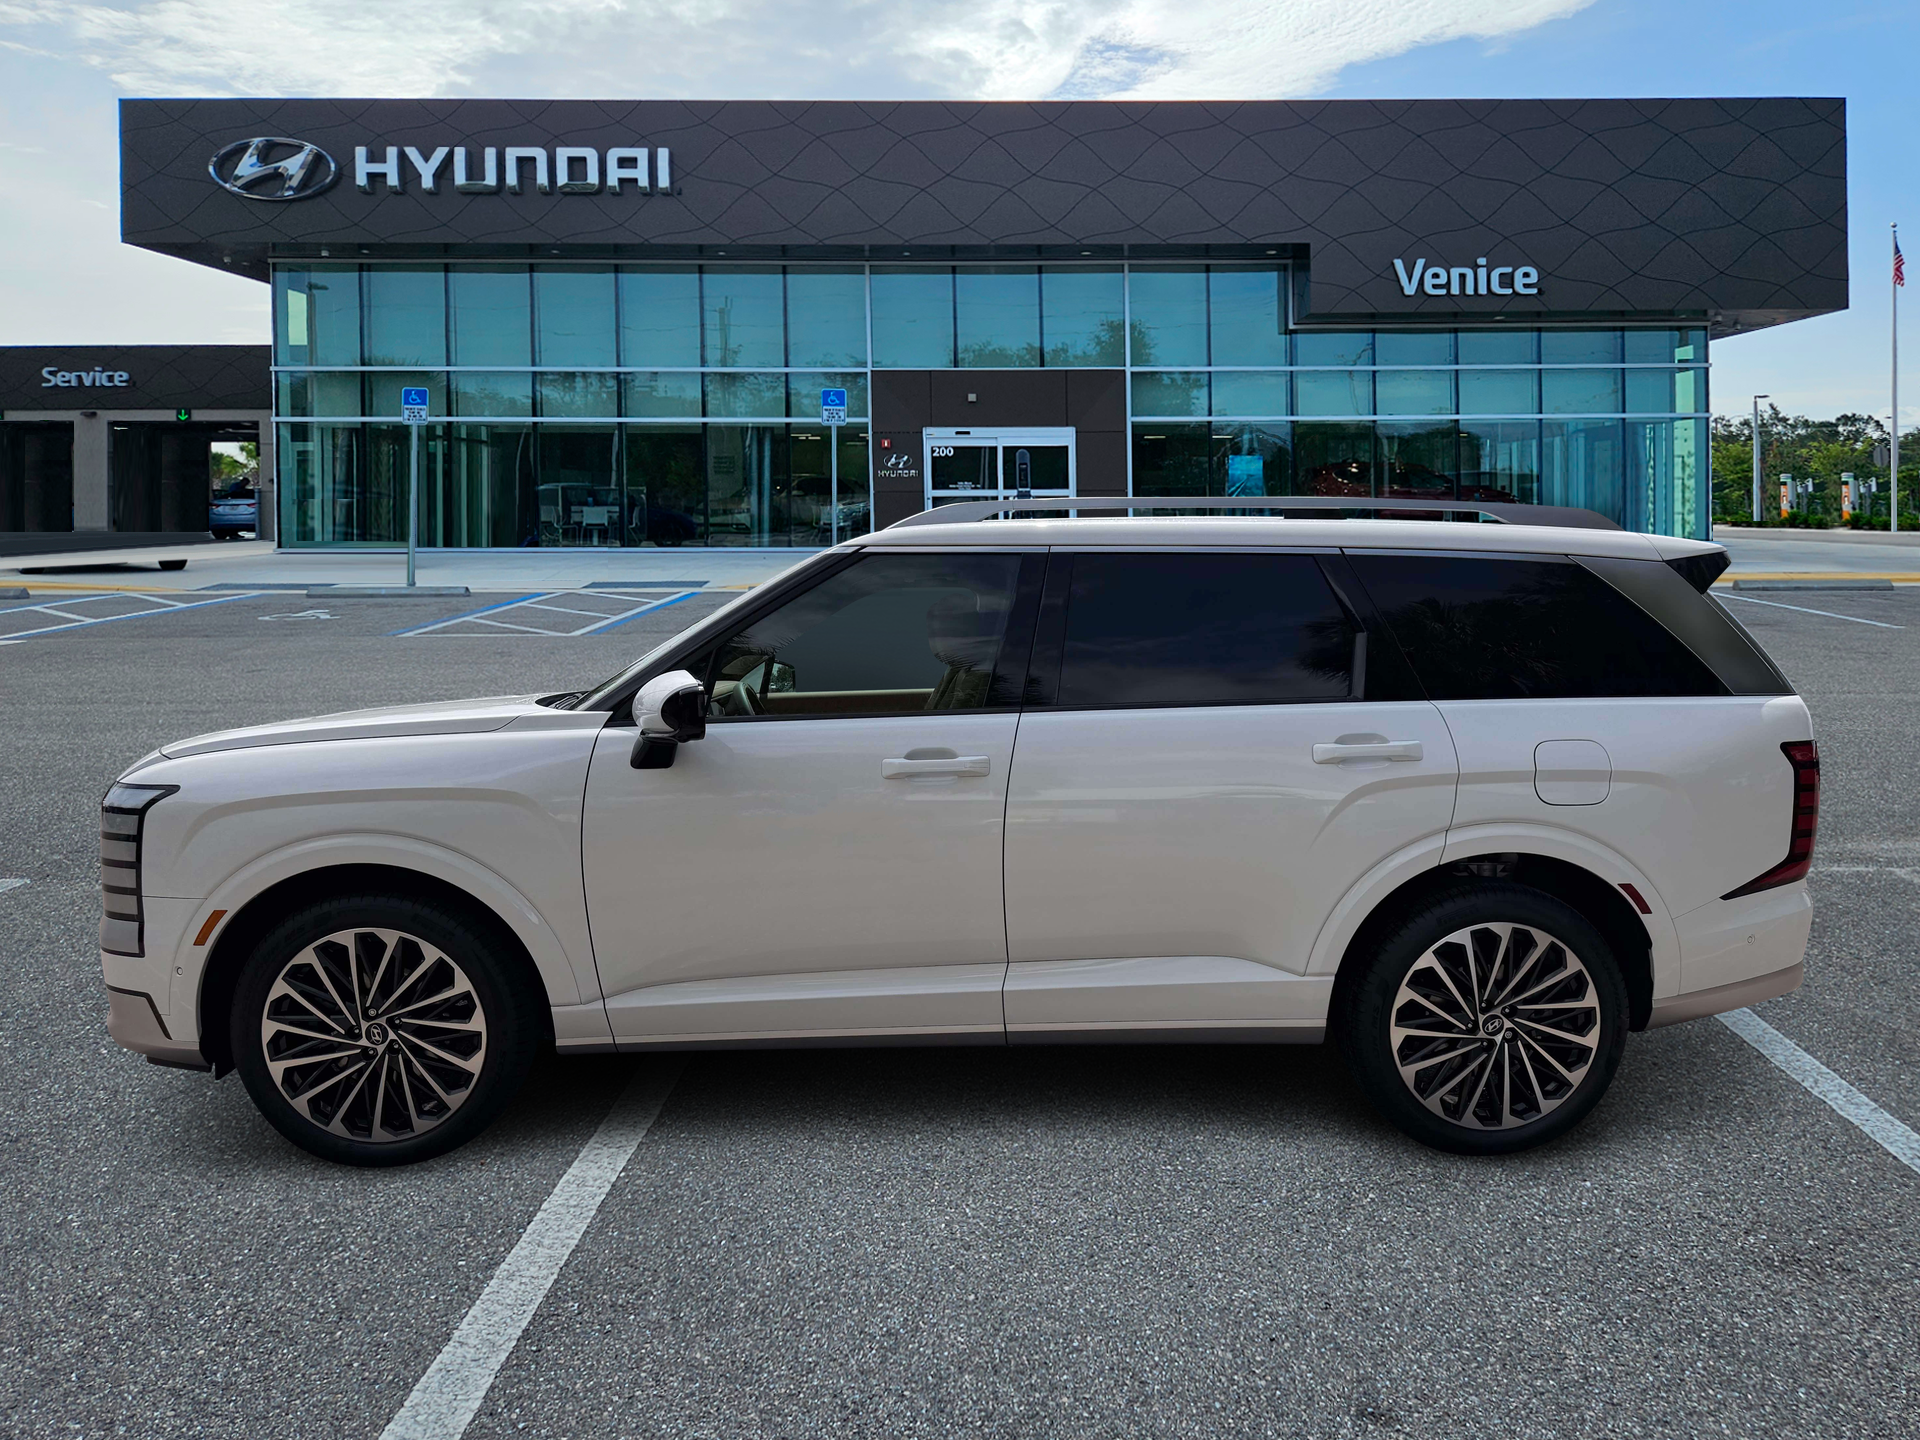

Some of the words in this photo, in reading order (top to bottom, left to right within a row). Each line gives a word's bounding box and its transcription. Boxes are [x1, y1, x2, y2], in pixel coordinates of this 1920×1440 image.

[354, 146, 674, 193] HYUNDAI
[1393, 257, 1539, 296] Venice
[41, 366, 129, 387] Service
[932, 446, 955, 457] 200
[877, 469, 919, 478] HYUNDAI
